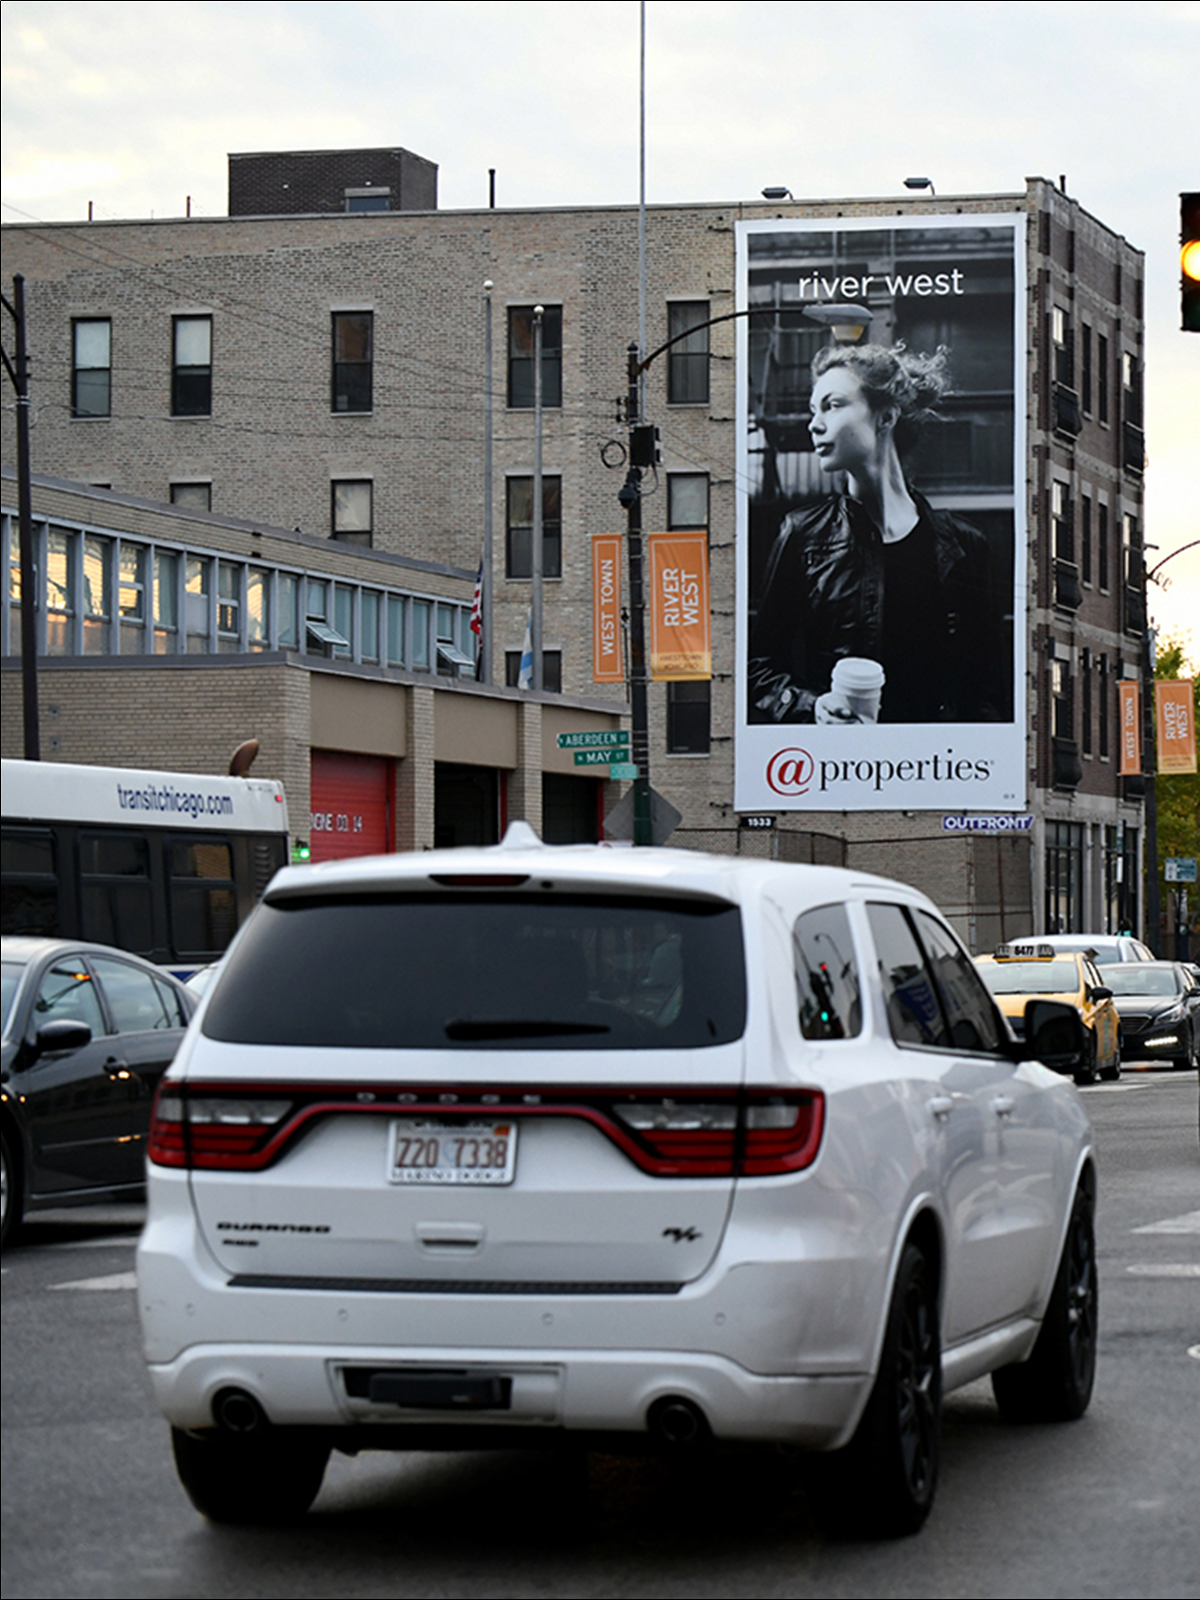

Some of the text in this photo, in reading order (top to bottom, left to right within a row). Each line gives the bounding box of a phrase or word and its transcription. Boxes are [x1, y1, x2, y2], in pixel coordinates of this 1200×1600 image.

[799, 268, 964, 298] river west
[601, 559, 615, 656] WEST TOWN
[662, 568, 680, 627] RIVER
[681, 569, 699, 627] WEST
[1125, 697, 1135, 759] WEST TOWN
[1164, 702, 1177, 739] RIVER
[1176, 704, 1189, 739] WEST
[565, 733, 618, 746] ABERDEEN
[586, 751, 612, 763] MAY
[117, 784, 234, 819] transitchicago.com
[944, 816, 1026, 829] OUTFRONT
[453, 1136, 509, 1169] 7338
